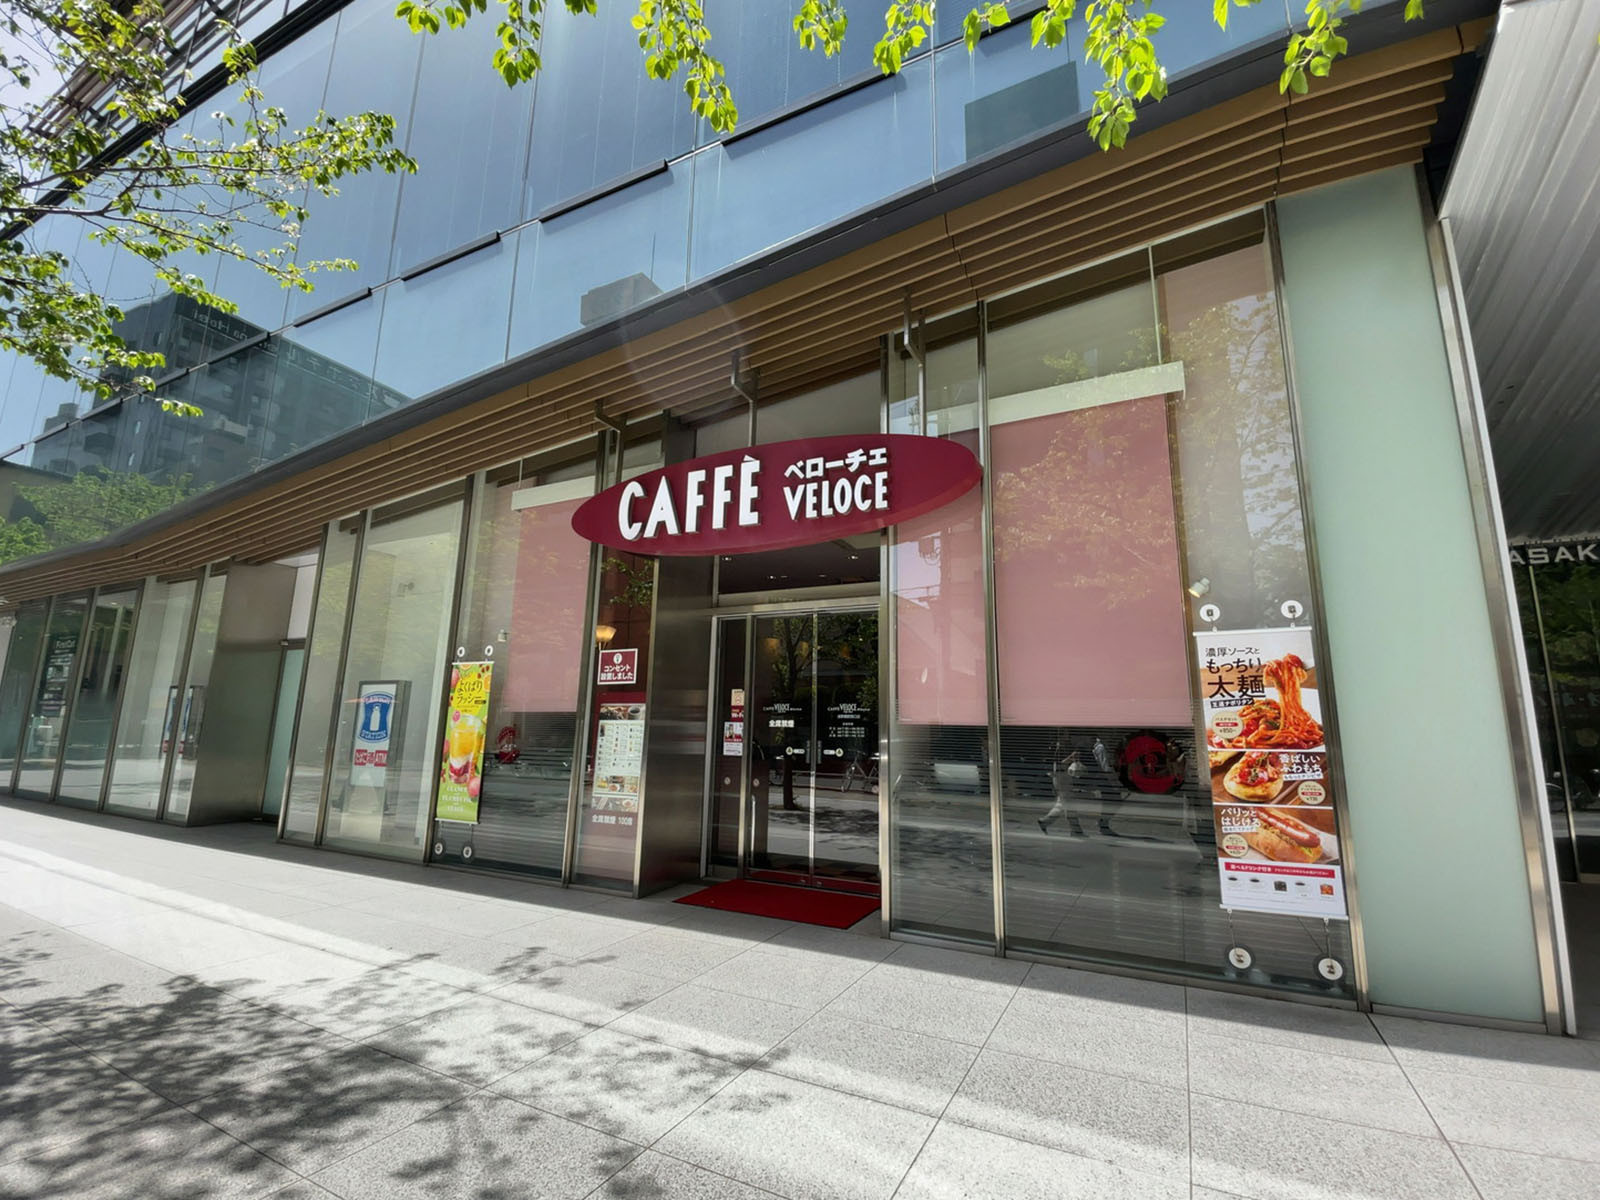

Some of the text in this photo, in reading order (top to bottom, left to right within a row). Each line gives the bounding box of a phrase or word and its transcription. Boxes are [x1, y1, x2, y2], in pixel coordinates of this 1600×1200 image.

[618, 454, 889, 541] CAFFÈ VELOCE
[1205, 646, 1261, 657] 濃厚ソースと
[603, 664, 630, 672] コンセント
[1206, 657, 1263, 674] もっちり
[1207, 674, 1266, 699] 太麺
